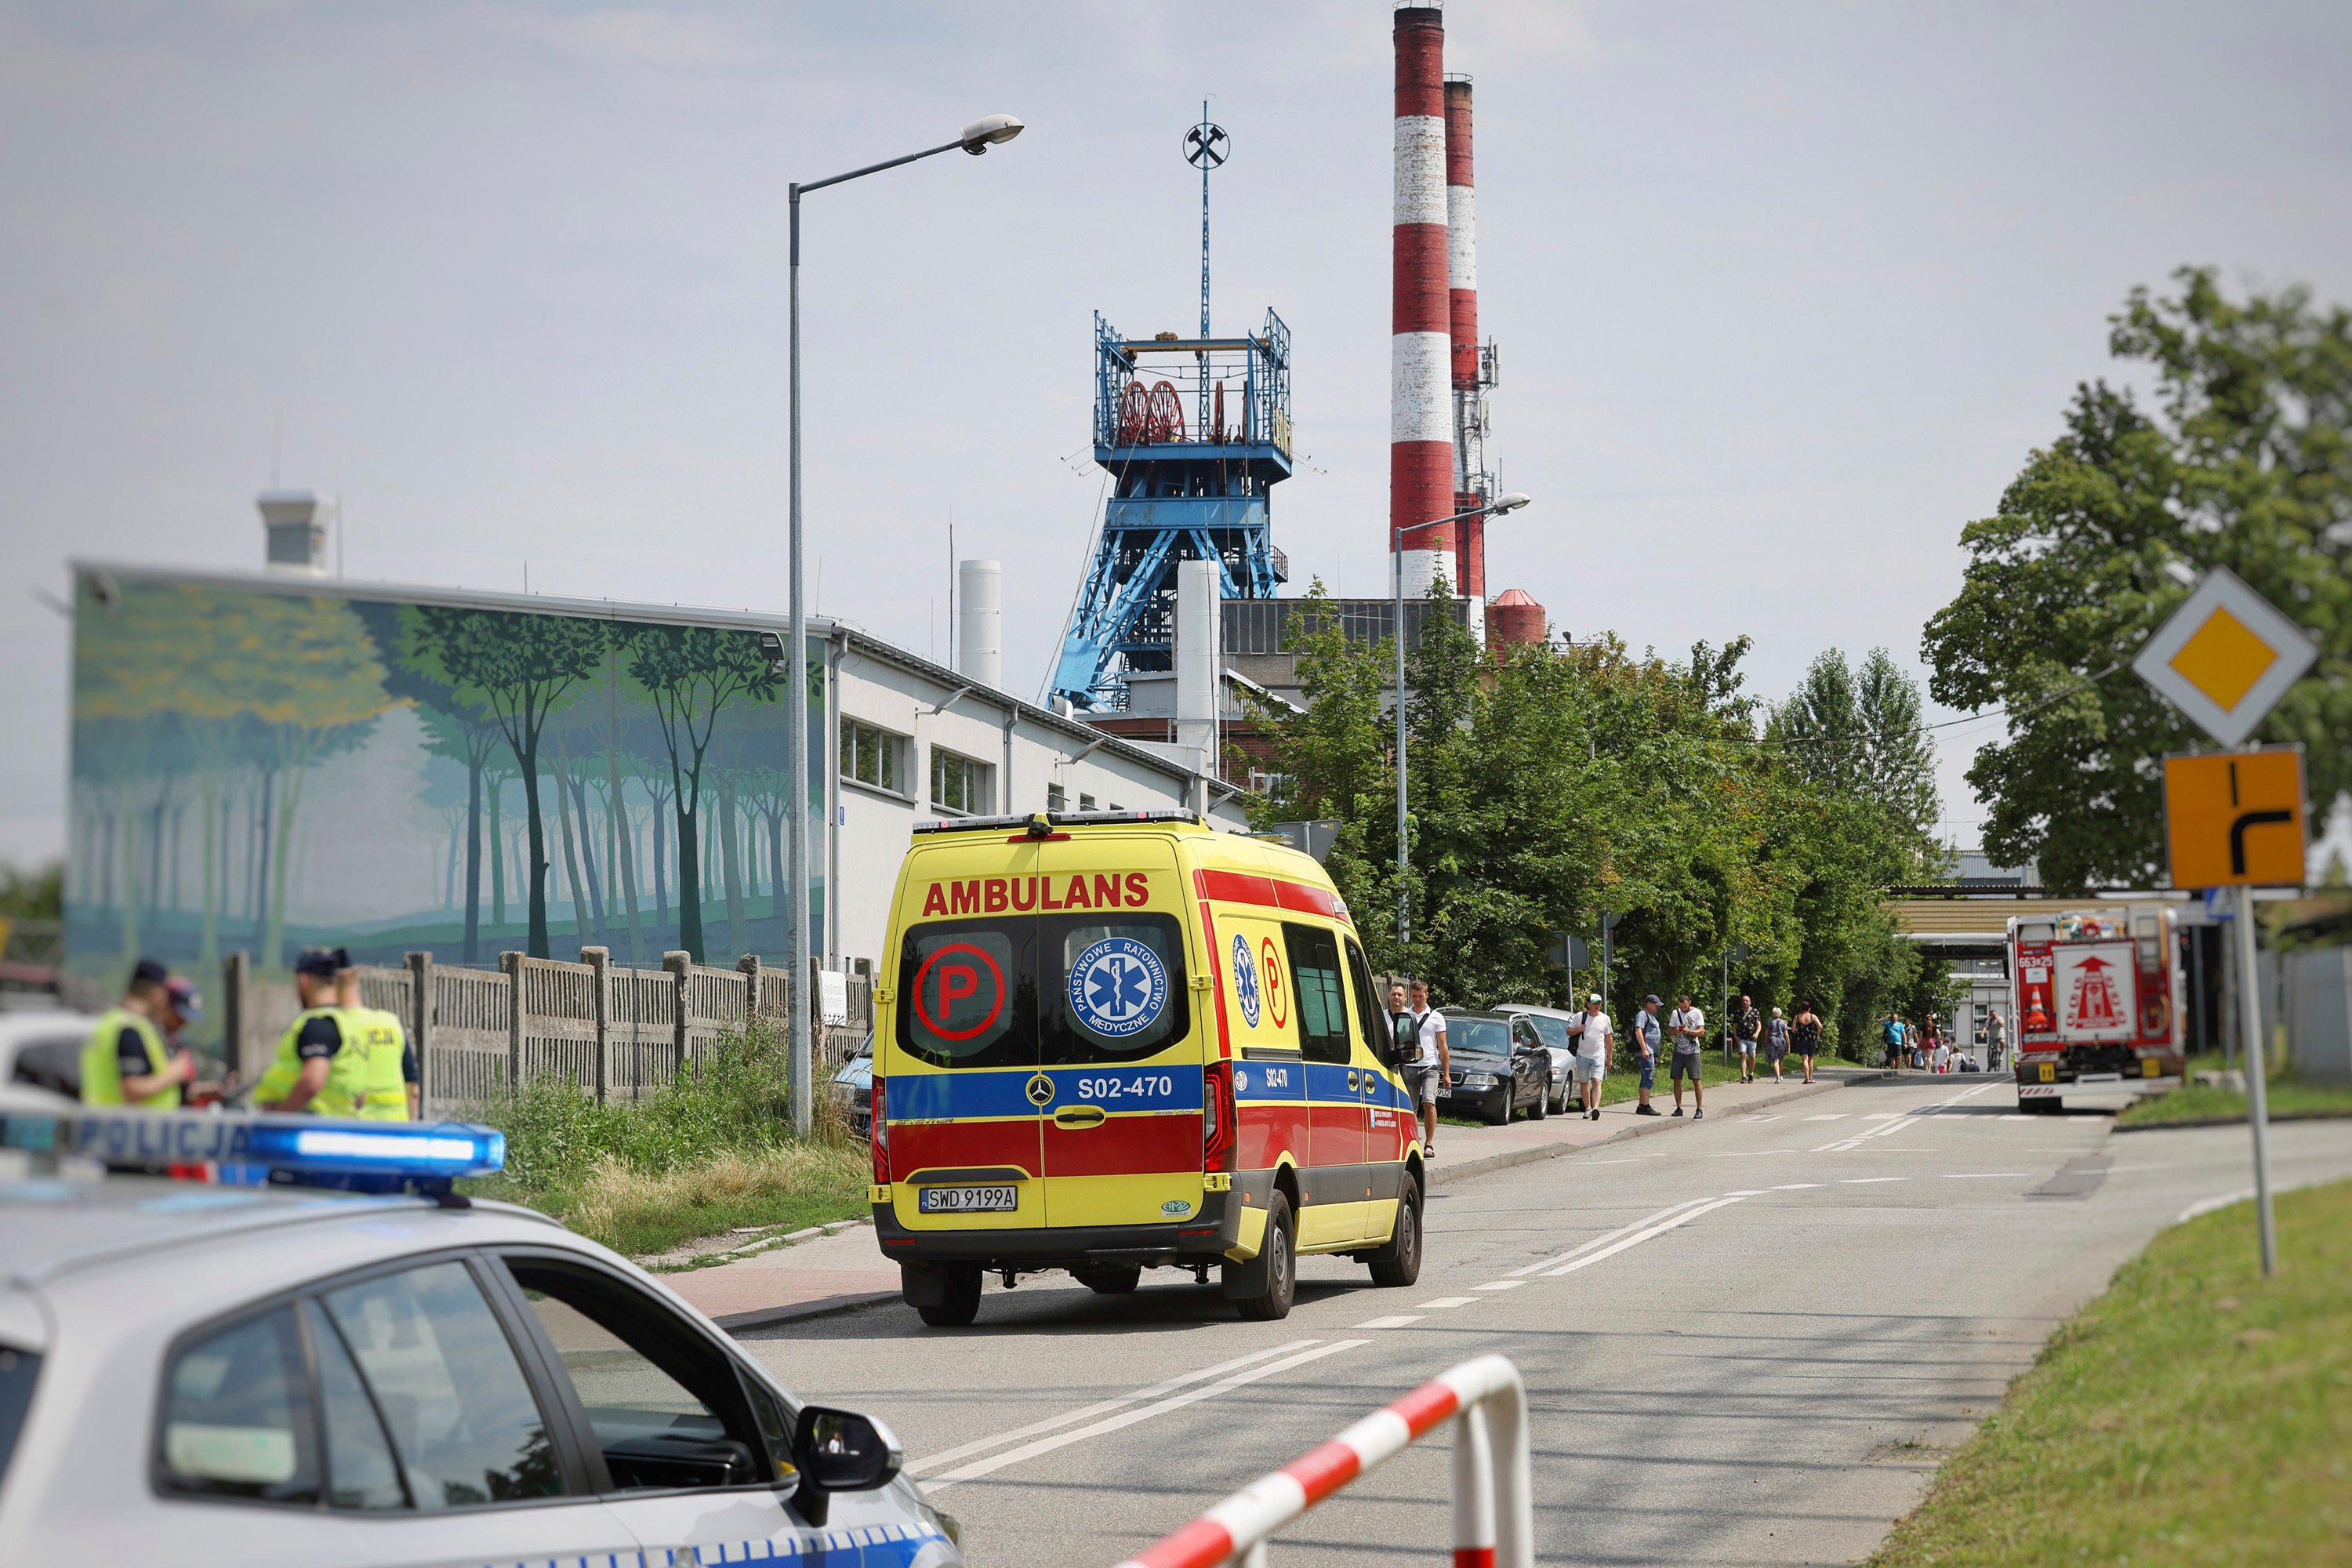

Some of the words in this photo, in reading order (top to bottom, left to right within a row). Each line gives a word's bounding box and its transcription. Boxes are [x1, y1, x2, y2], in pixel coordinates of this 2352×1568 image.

[922, 873, 1149, 916] AMBULANS
[938, 964, 978, 1019] P
[1071, 942, 1112, 1012] PAŃSTWOWE
[1123, 942, 1164, 1011] RATOWNICTWO
[1266, 956, 1279, 1008] P
[1088, 1012, 1150, 1033] MEDYCZNE
[1078, 1076, 1173, 1099] S02-470
[1265, 1068, 1288, 1088] S02-470
[79, 1116, 255, 1159] POLICJA
[929, 1190, 960, 1207] SWD
[964, 1189, 1013, 1207] 9199A
